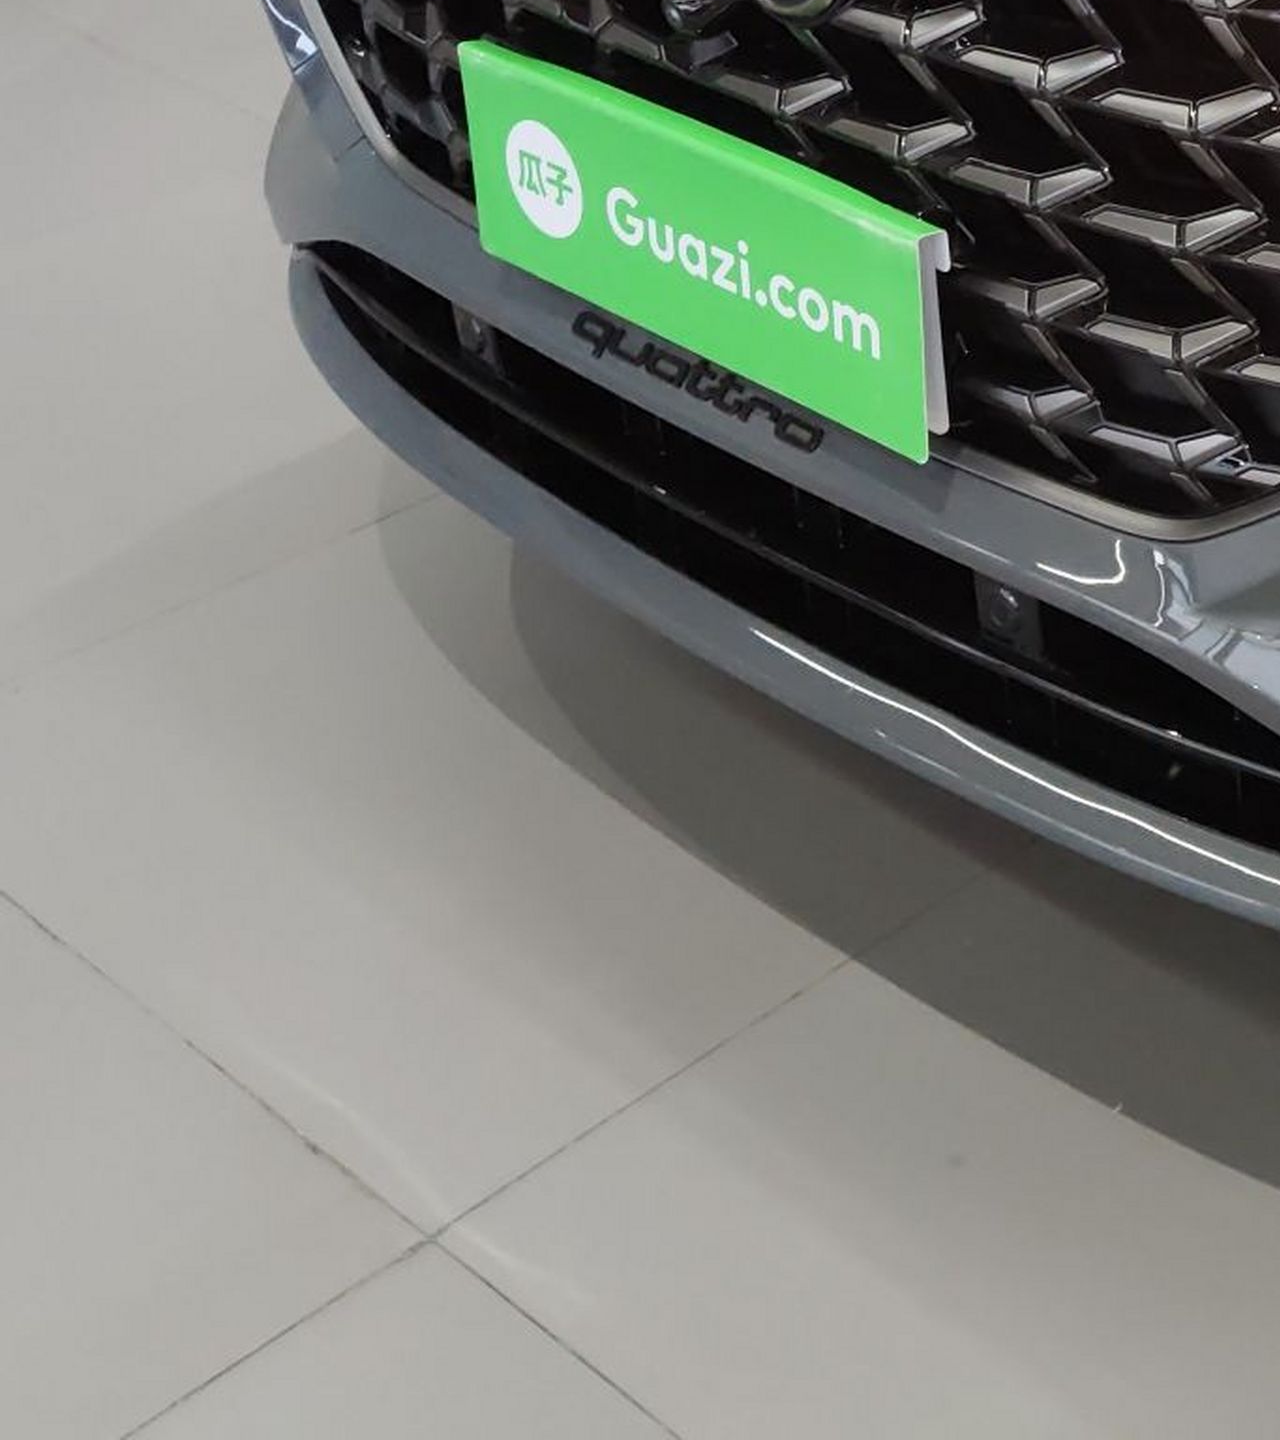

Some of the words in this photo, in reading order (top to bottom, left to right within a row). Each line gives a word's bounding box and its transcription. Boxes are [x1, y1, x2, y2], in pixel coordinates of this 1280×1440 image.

[517, 149, 573, 206] 瓜子
[605, 186, 883, 361] Guazi.com
[571, 310, 825, 454] quattro
